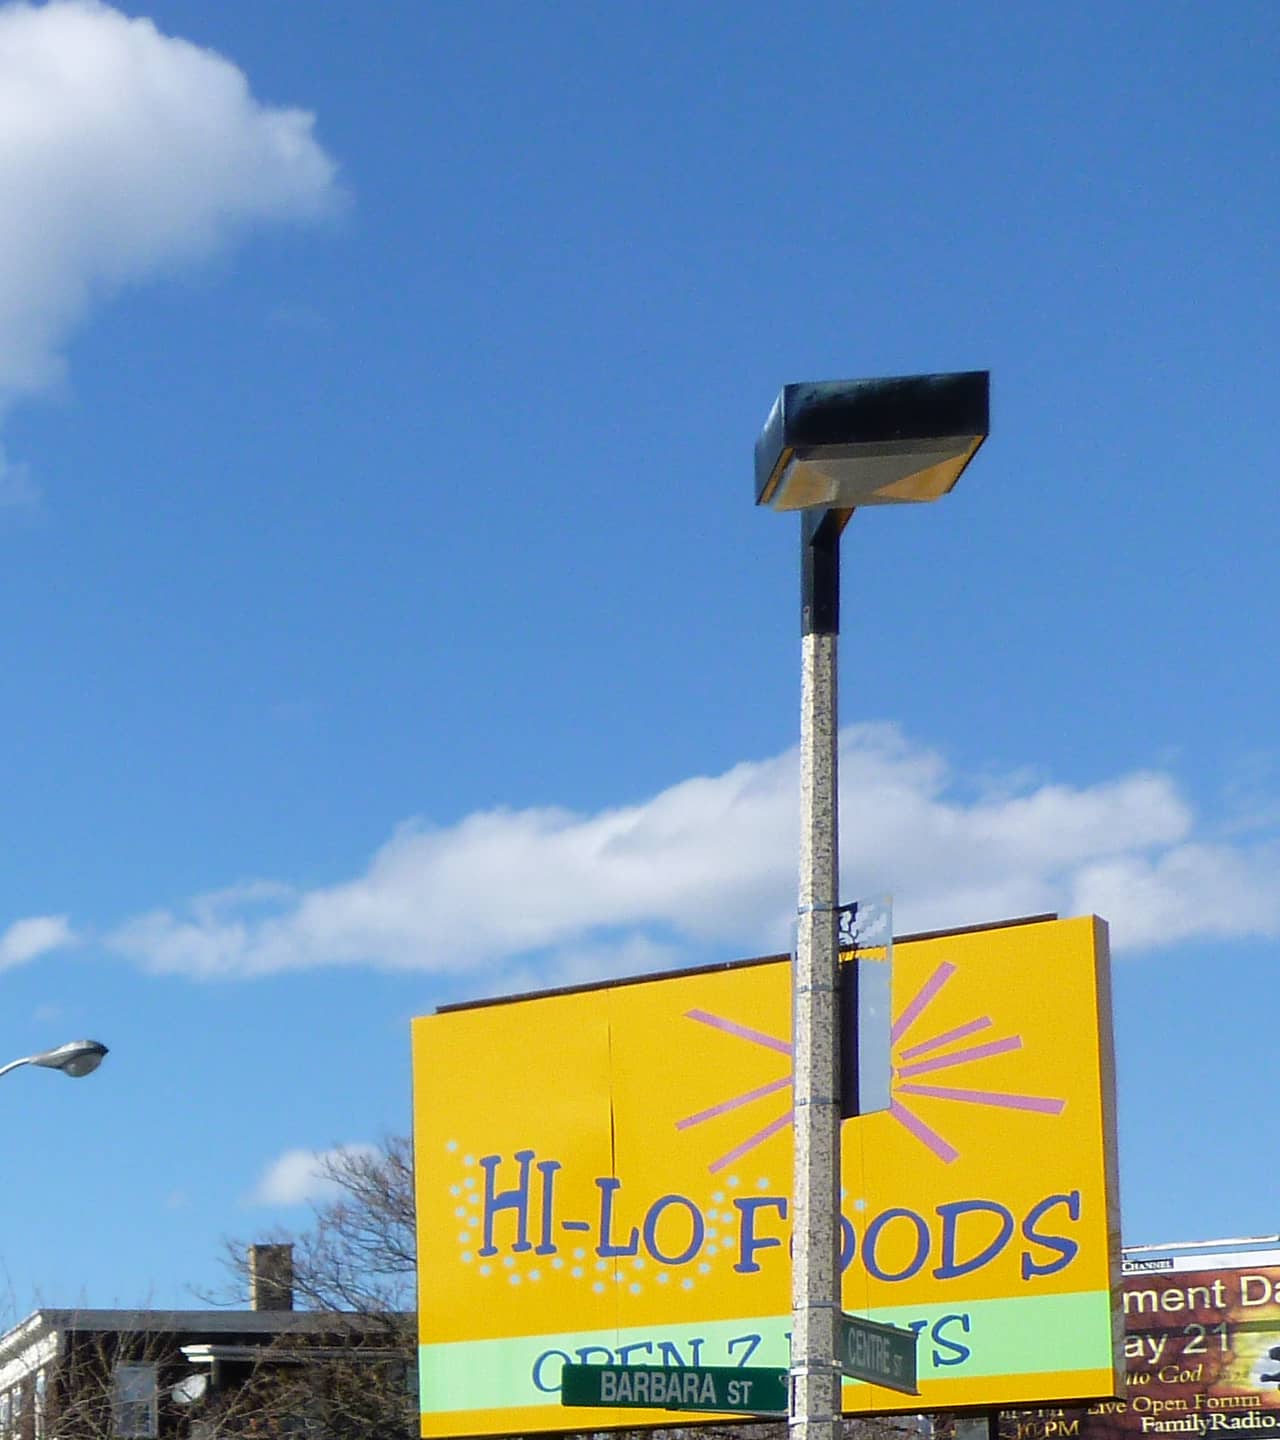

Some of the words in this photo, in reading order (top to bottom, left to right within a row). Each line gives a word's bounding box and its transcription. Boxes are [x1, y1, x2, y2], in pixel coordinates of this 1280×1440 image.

[478, 1150, 705, 1266] HI-LO
[732, 1190, 1082, 1282] FODS
[847, 1327, 890, 1375] CENTRE
[892, 1353, 904, 1377] ST
[1182, 1321, 1232, 1354] 21
[600, 1370, 716, 1405] BARBARA
[727, 1380, 753, 1405] ST
[1158, 1363, 1203, 1384] God
[1132, 1396, 1188, 1416] Open
[1193, 1393, 1262, 1410] Forum
[1044, 1420, 1080, 1438] PM
